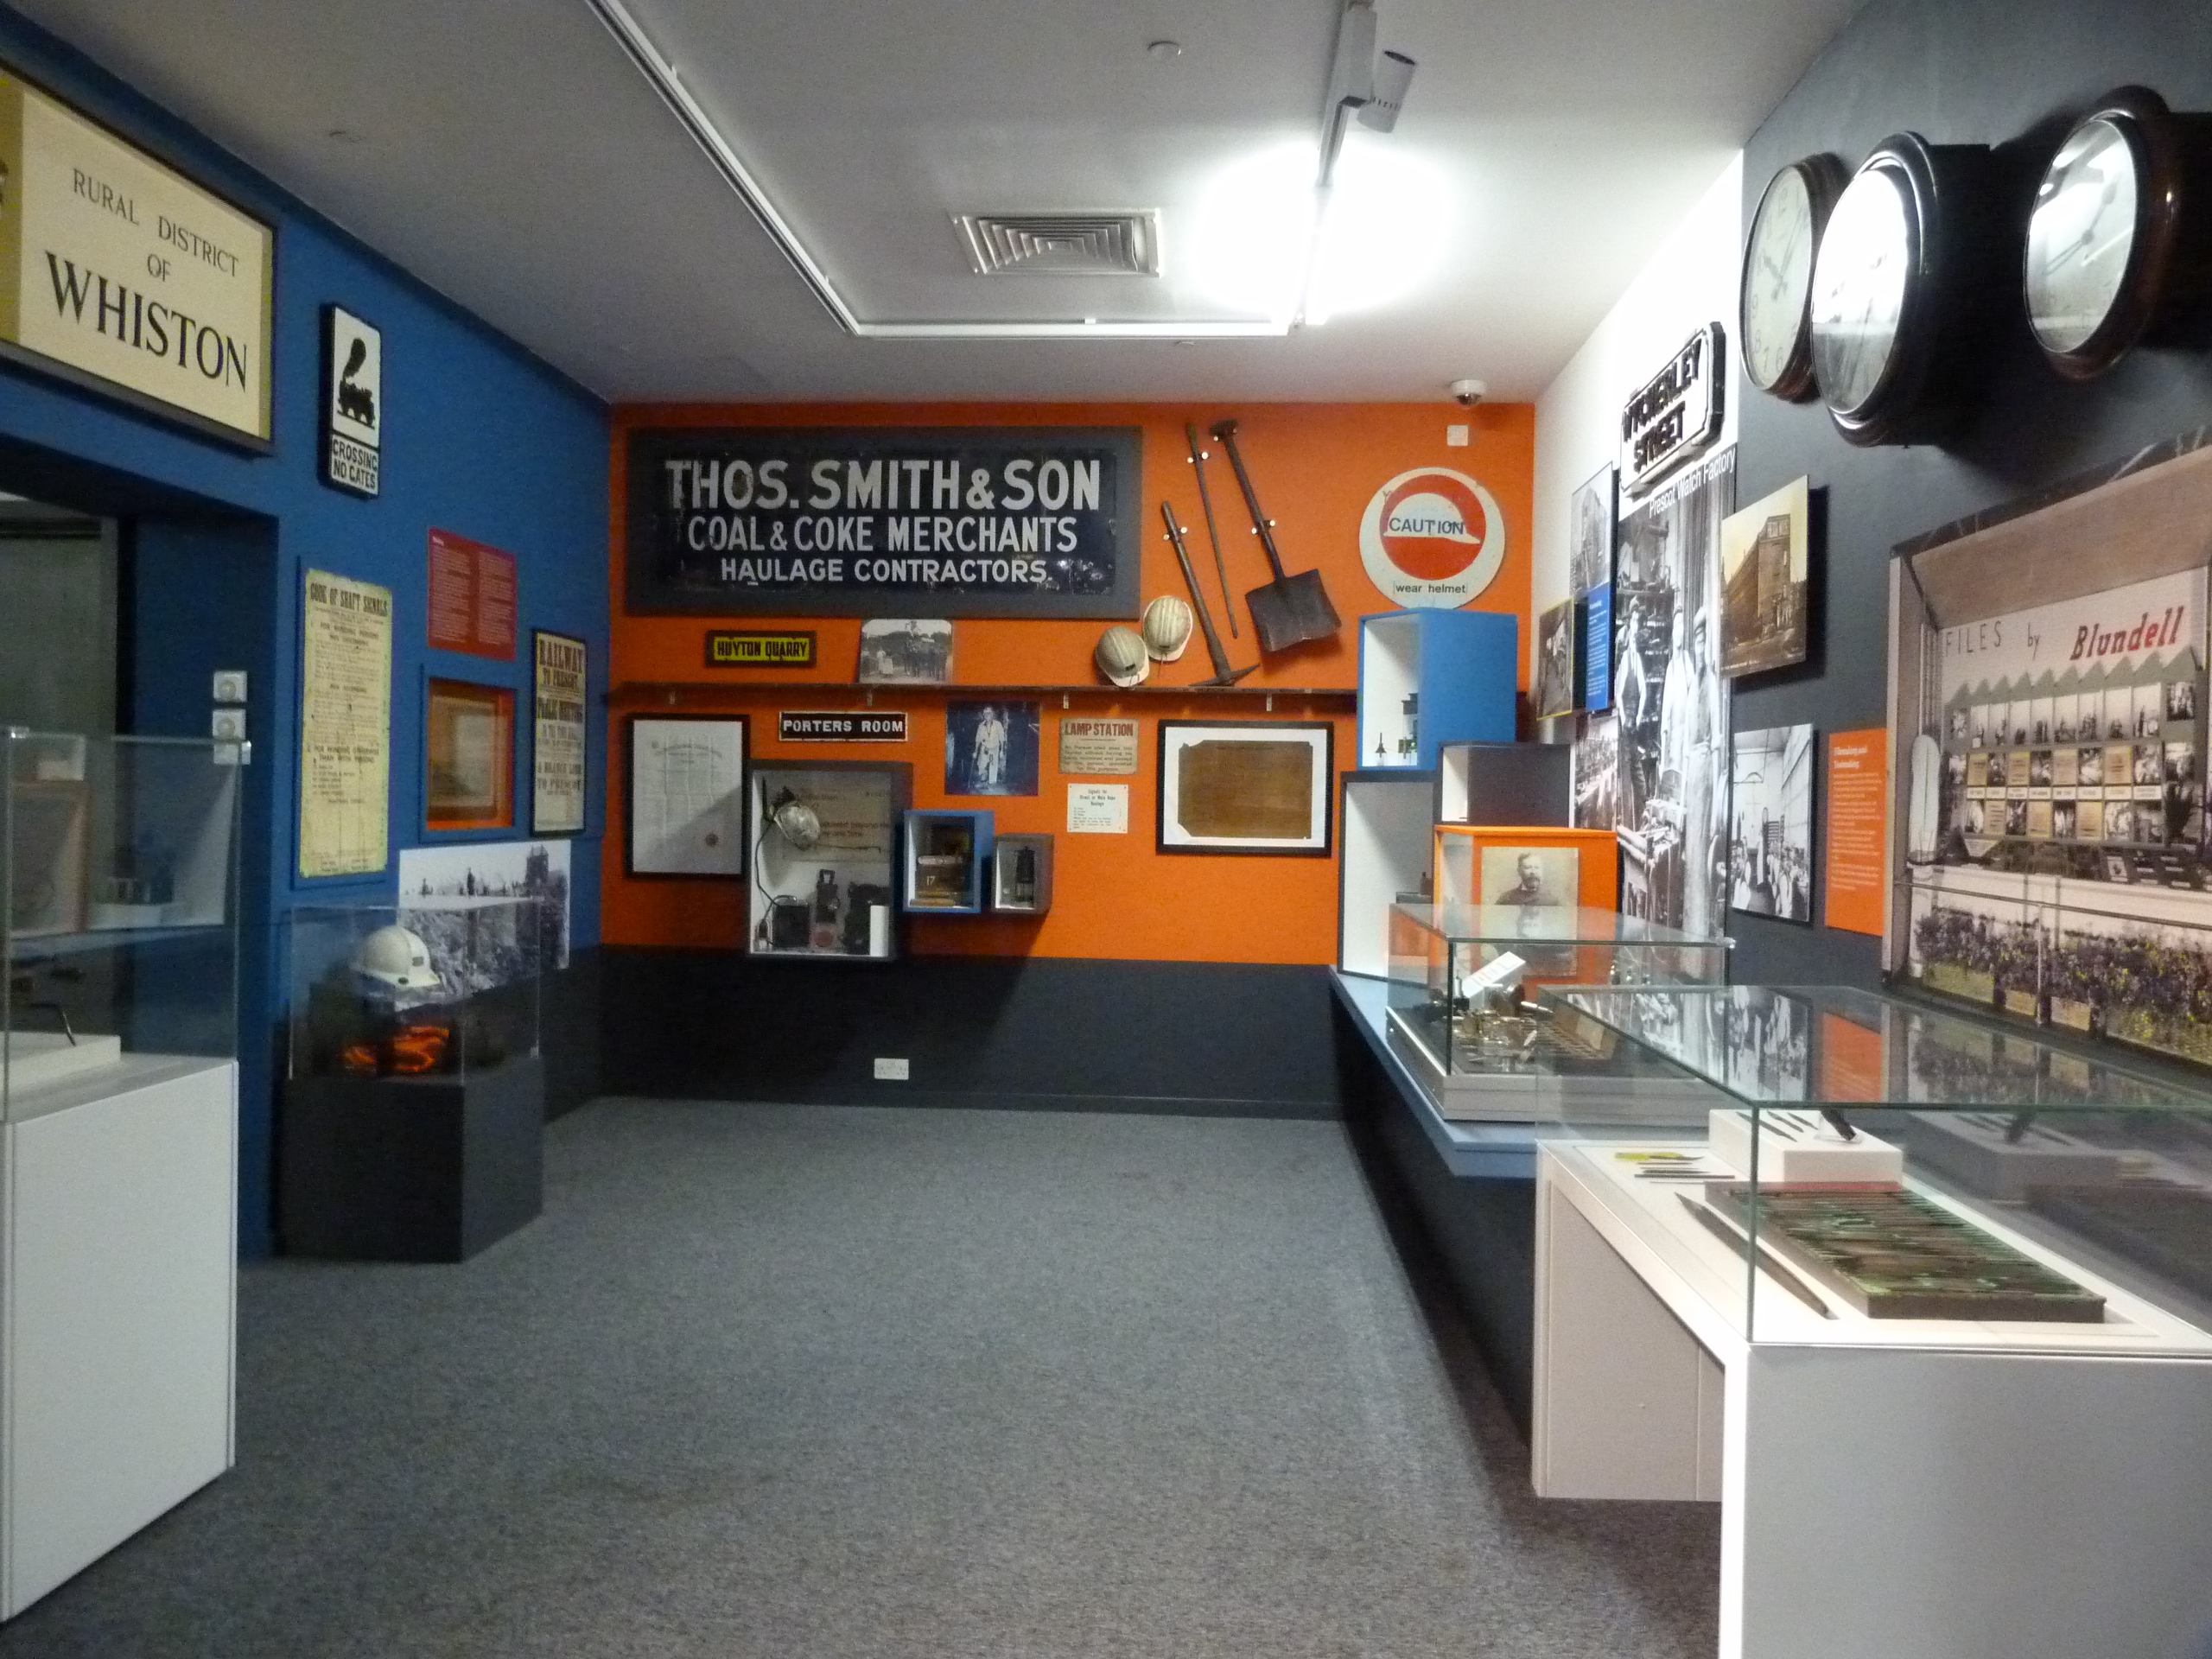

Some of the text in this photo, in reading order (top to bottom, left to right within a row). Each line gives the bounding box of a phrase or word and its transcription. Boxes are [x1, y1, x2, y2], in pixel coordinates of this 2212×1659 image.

[73, 168, 239, 277] RURAL DISTRICT
[147, 254, 171, 282] OF
[44, 250, 248, 393] WHISTON
[1633, 400, 1686, 474] STREET
[334, 458, 346, 479] NO
[1649, 447, 1736, 518] Prescot Watch Factory
[665, 459, 1101, 512] THOS. SMITH & SON
[688, 516, 1077, 553] COAL & COKE MERCHANTS
[1389, 518, 1464, 535] CAUTION
[721, 558, 843, 582] HAULAGE
[1395, 582, 1466, 594] wear helmet
[1944, 606, 2185, 661] FILES by Blundell
[717, 640, 808, 659] HUYTON QUARRY
[783, 720, 903, 733] PORTERS ROOM
[1065, 722, 1133, 737] LAMP STATION
